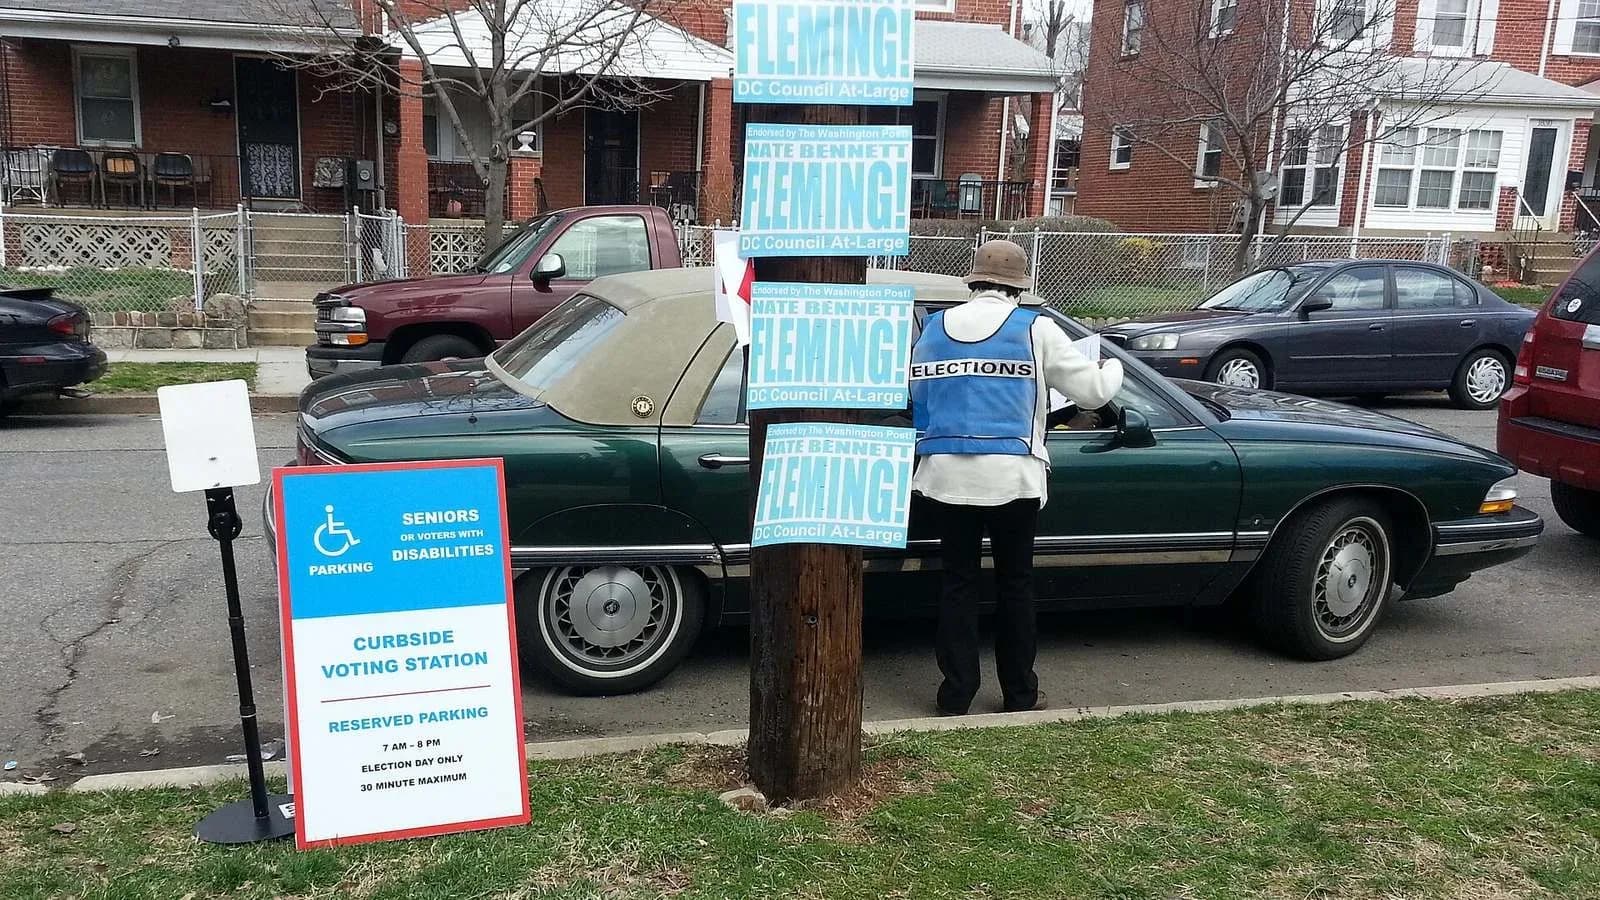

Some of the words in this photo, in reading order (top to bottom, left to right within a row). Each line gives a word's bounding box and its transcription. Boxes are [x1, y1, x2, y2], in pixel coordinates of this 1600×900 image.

[737, 4, 912, 79] FLEMING!
[738, 81, 763, 95] DC
[769, 81, 834, 97] Council
[839, 82, 909, 101] At-Large
[748, 127, 784, 138] Endorsed
[786, 128, 797, 139] by
[798, 128, 815, 138] The
[817, 128, 879, 140] Washington
[747, 143, 794, 158] NATE
[799, 143, 909, 159] BENNETT
[743, 160, 908, 230] FLEMING!
[741, 236, 760, 250] DC
[764, 235, 825, 249] Council
[831, 236, 904, 251] At-Large
[752, 286, 788, 295] Endorsed
[790, 287, 800, 297] by
[803, 287, 821, 297] The
[824, 287, 882, 299] Washington
[884, 289, 911, 298] Post!
[752, 300, 799, 315] NATE
[805, 301, 911, 317] BENNETT
[750, 317, 909, 385] FLEMING!
[911, 361, 1032, 378] ELECTIONS
[750, 388, 767, 402] DC
[770, 387, 830, 401] Council
[834, 388, 903, 405] At-Large
[768, 426, 798, 436] Endorsed
[799, 427, 807, 436] by
[808, 426, 823, 435] The
[825, 426, 884, 439] Washington
[886, 430, 912, 440] Post!
[767, 440, 804, 455] NATE
[808, 440, 911, 458] BENNETT
[757, 455, 911, 523] FLEMING!
[402, 509, 480, 526] SENIORS
[400, 533, 415, 542] OR
[417, 531, 456, 541] VOTERS
[458, 529, 484, 539] WITH
[754, 526, 771, 540] DC
[774, 525, 826, 539] Council
[831, 525, 903, 544] At-Large
[392, 544, 494, 561] DISABILITIES
[309, 562, 374, 576] PARKING
[353, 630, 454, 650] CURBSIDE
[321, 659, 399, 679] VOTING
[405, 651, 488, 672] STATION
[328, 714, 414, 733] RESERVED
[419, 707, 488, 724] PARKING
[383, 744, 389, 752] 7
[392, 742, 407, 751] AM
[417, 740, 423, 749] 8
[426, 738, 441, 748] PM
[361, 760, 412, 773] ELECTION
[415, 758, 435, 767] DAY
[437, 754, 463, 764] ONLY
[360, 783, 373, 792] 30
[375, 778, 416, 790] MINUTE
[418, 772, 467, 785] MAXIMUM
